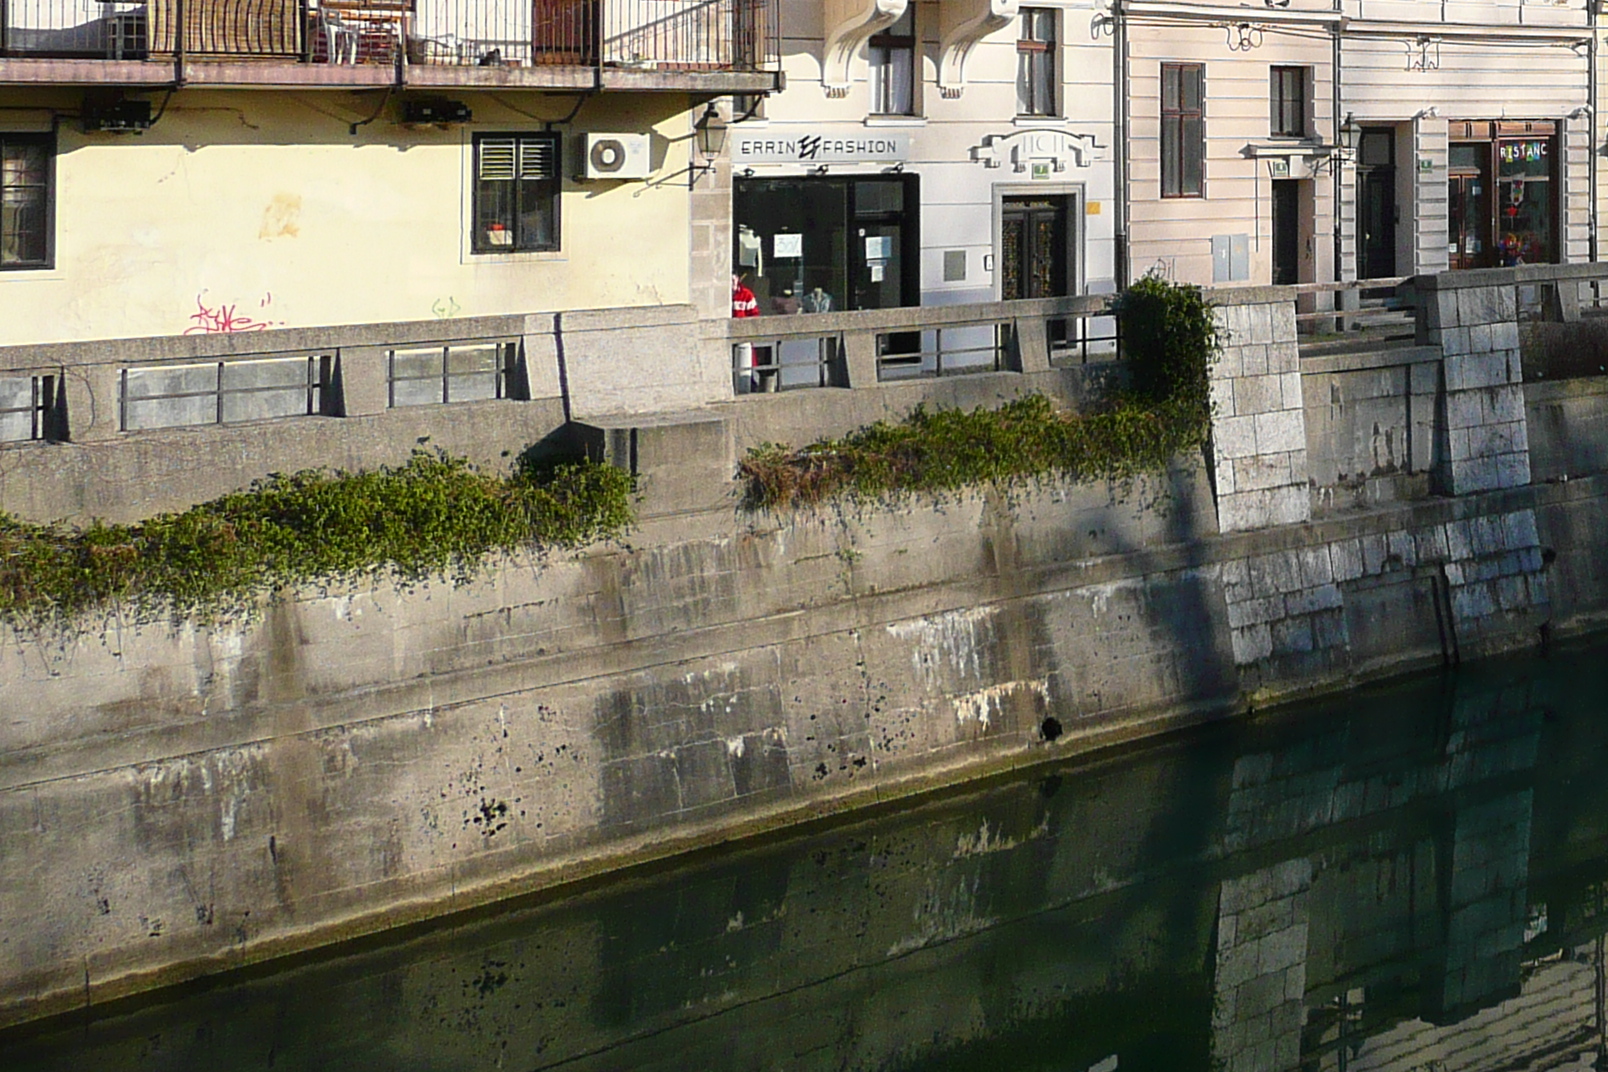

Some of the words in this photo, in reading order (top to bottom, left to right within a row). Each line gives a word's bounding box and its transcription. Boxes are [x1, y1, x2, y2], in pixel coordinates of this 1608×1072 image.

[741, 141, 796, 154] ERRIN
[823, 140, 896, 154] FASHION
[1500, 143, 1548, 159] RISTANC
